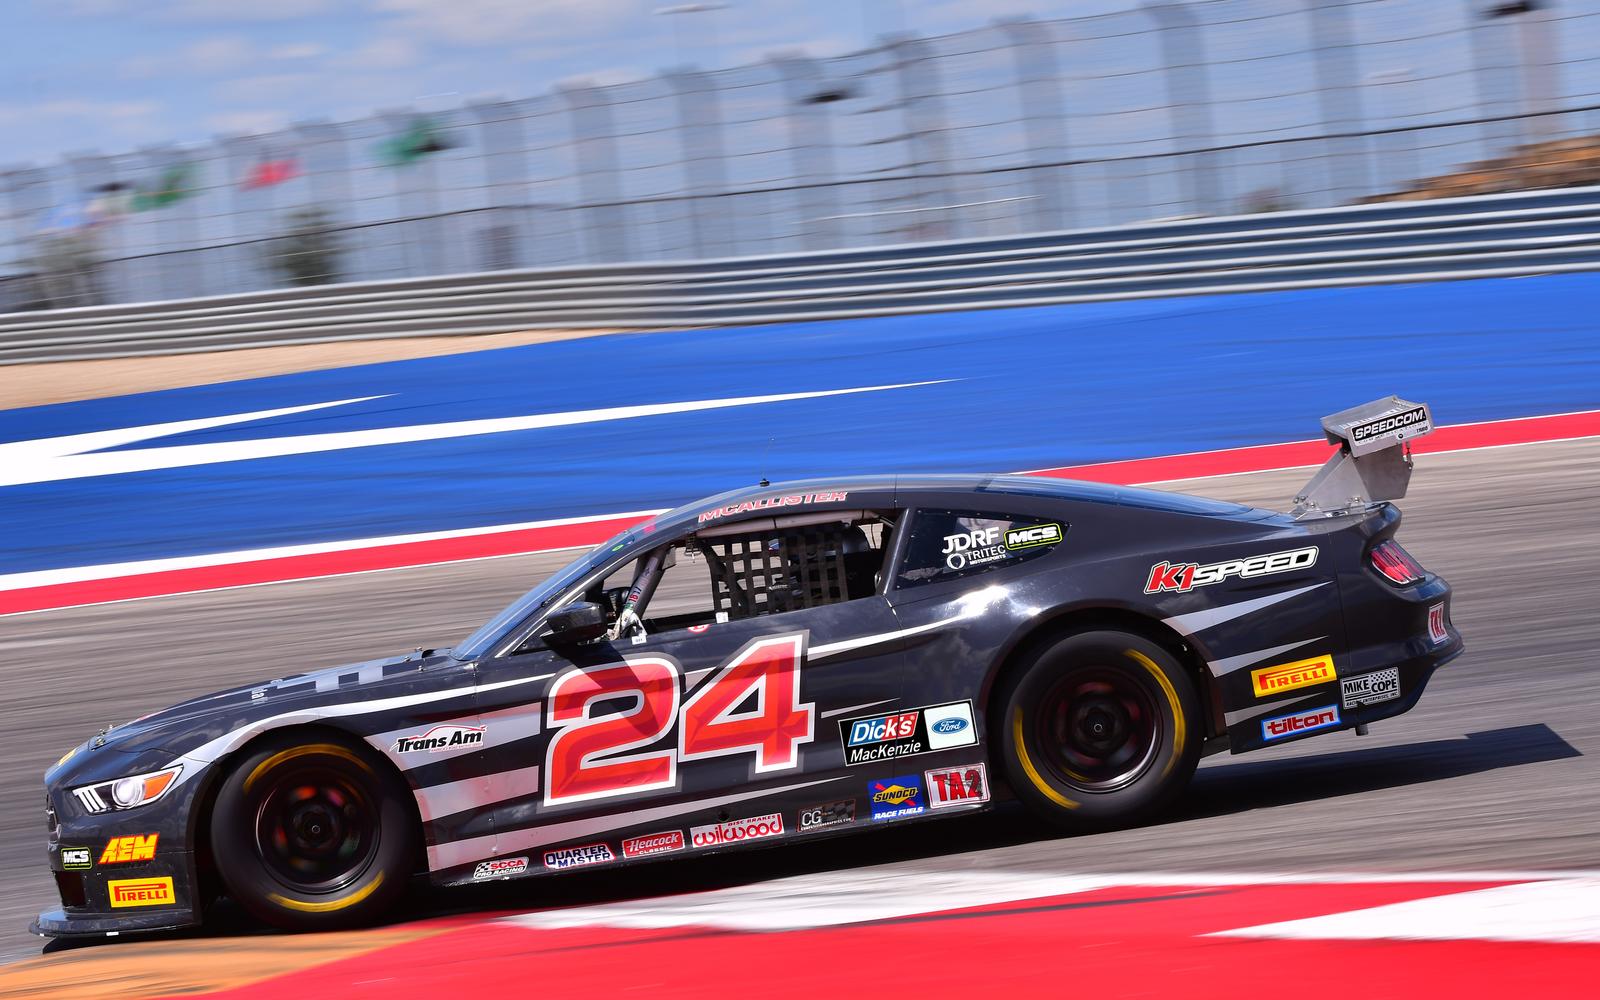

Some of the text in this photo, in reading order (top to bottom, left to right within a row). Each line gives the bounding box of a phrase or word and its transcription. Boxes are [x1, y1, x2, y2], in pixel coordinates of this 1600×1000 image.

[1355, 409, 1424, 439] SPEEDCOM
[698, 491, 848, 522] MCALLISTER
[942, 527, 999, 553] JDRF
[1009, 527, 1057, 544] MCS
[965, 545, 1006, 560] TRITEC
[1258, 661, 1328, 690] PIRELLI
[1344, 678, 1397, 694] MIKE COPE
[543, 633, 816, 806] 24
[939, 720, 962, 732] Ford
[1267, 710, 1335, 735] tilton
[398, 737, 447, 752] Trans
[449, 731, 482, 746] Am
[850, 740, 921, 763] MacKenzie
[874, 787, 918, 801] SUNOCO
[933, 769, 983, 802] TA2
[746, 814, 776, 823] BRAKES
[802, 810, 821, 826] CG
[874, 806, 924, 820] RACE FUELS
[693, 814, 783, 847] wilwood
[97, 833, 160, 865] AEM
[626, 833, 680, 853] Heacock
[639, 845, 672, 855] CLASSIC
[63, 850, 90, 863] MCS
[490, 859, 525, 870] SCCA
[545, 844, 607, 866] QUARTER
[557, 852, 612, 868] MASTER
[475, 866, 525, 879] PRO RACING
[113, 882, 168, 902] PIRELLI
